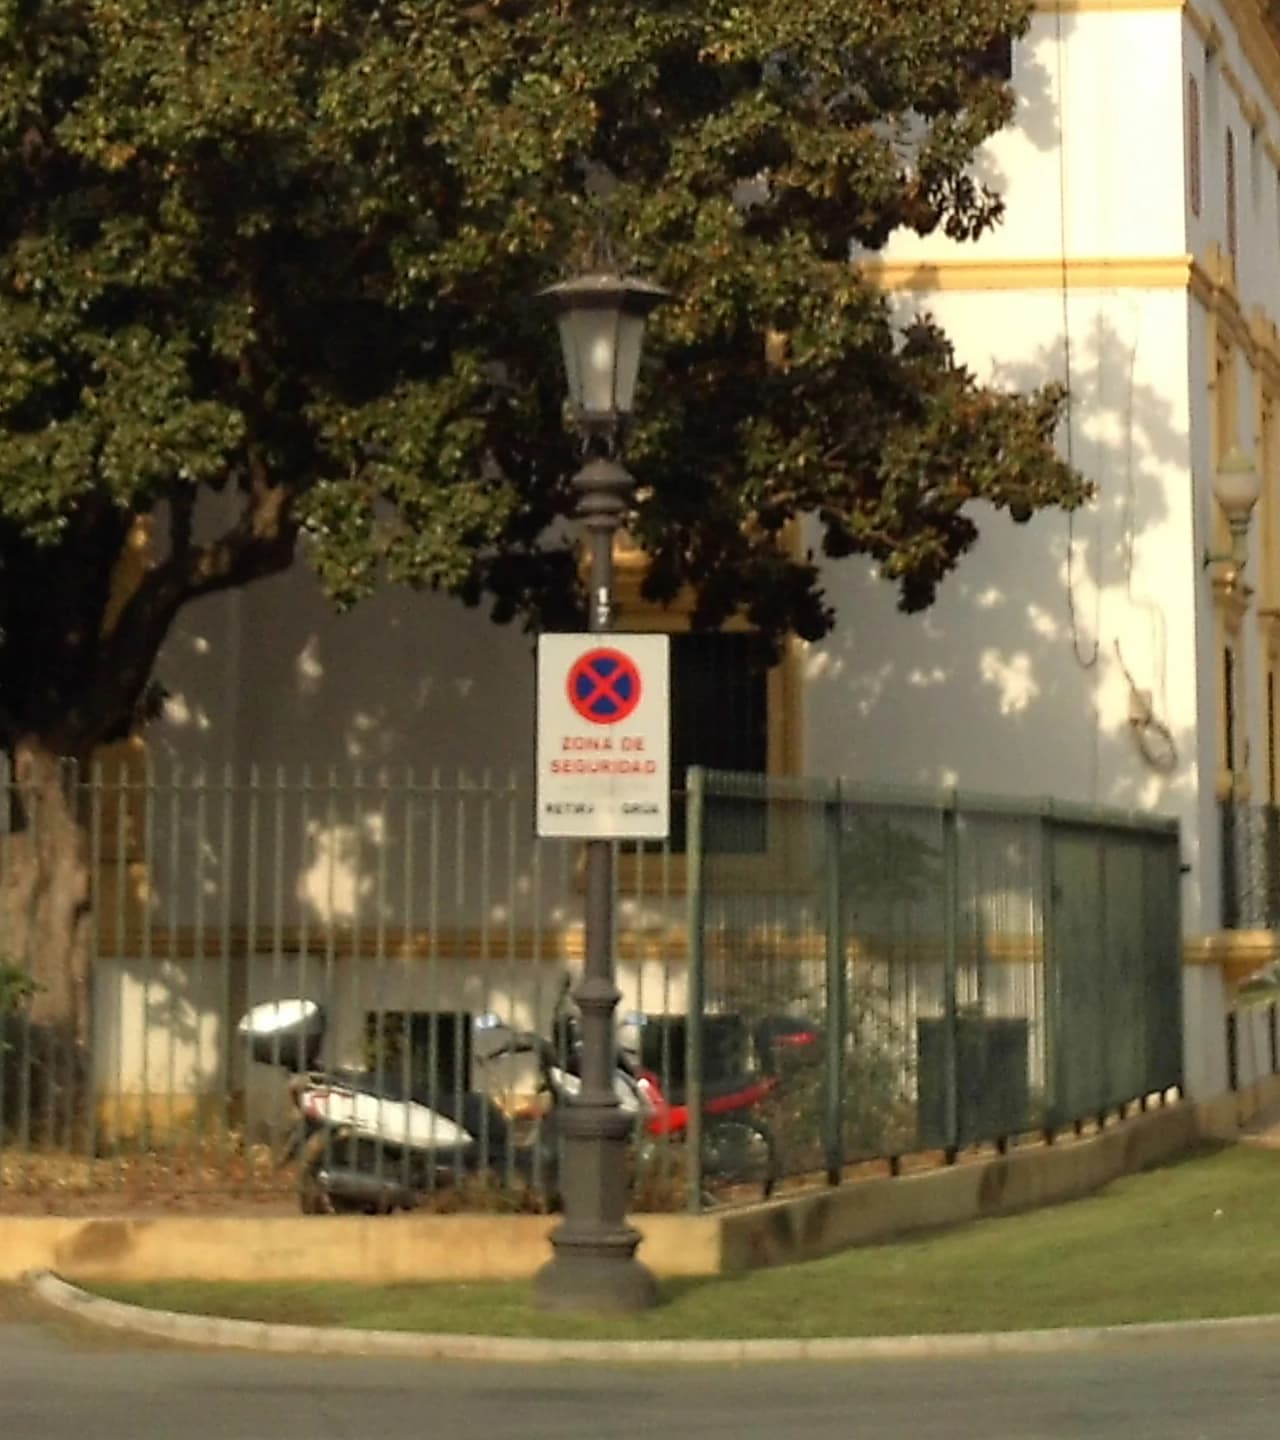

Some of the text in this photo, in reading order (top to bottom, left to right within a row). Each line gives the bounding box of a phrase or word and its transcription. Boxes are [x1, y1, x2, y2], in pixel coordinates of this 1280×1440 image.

[562, 736, 646, 751] ZONA DE
[550, 759, 657, 774] SEGURIDAD
